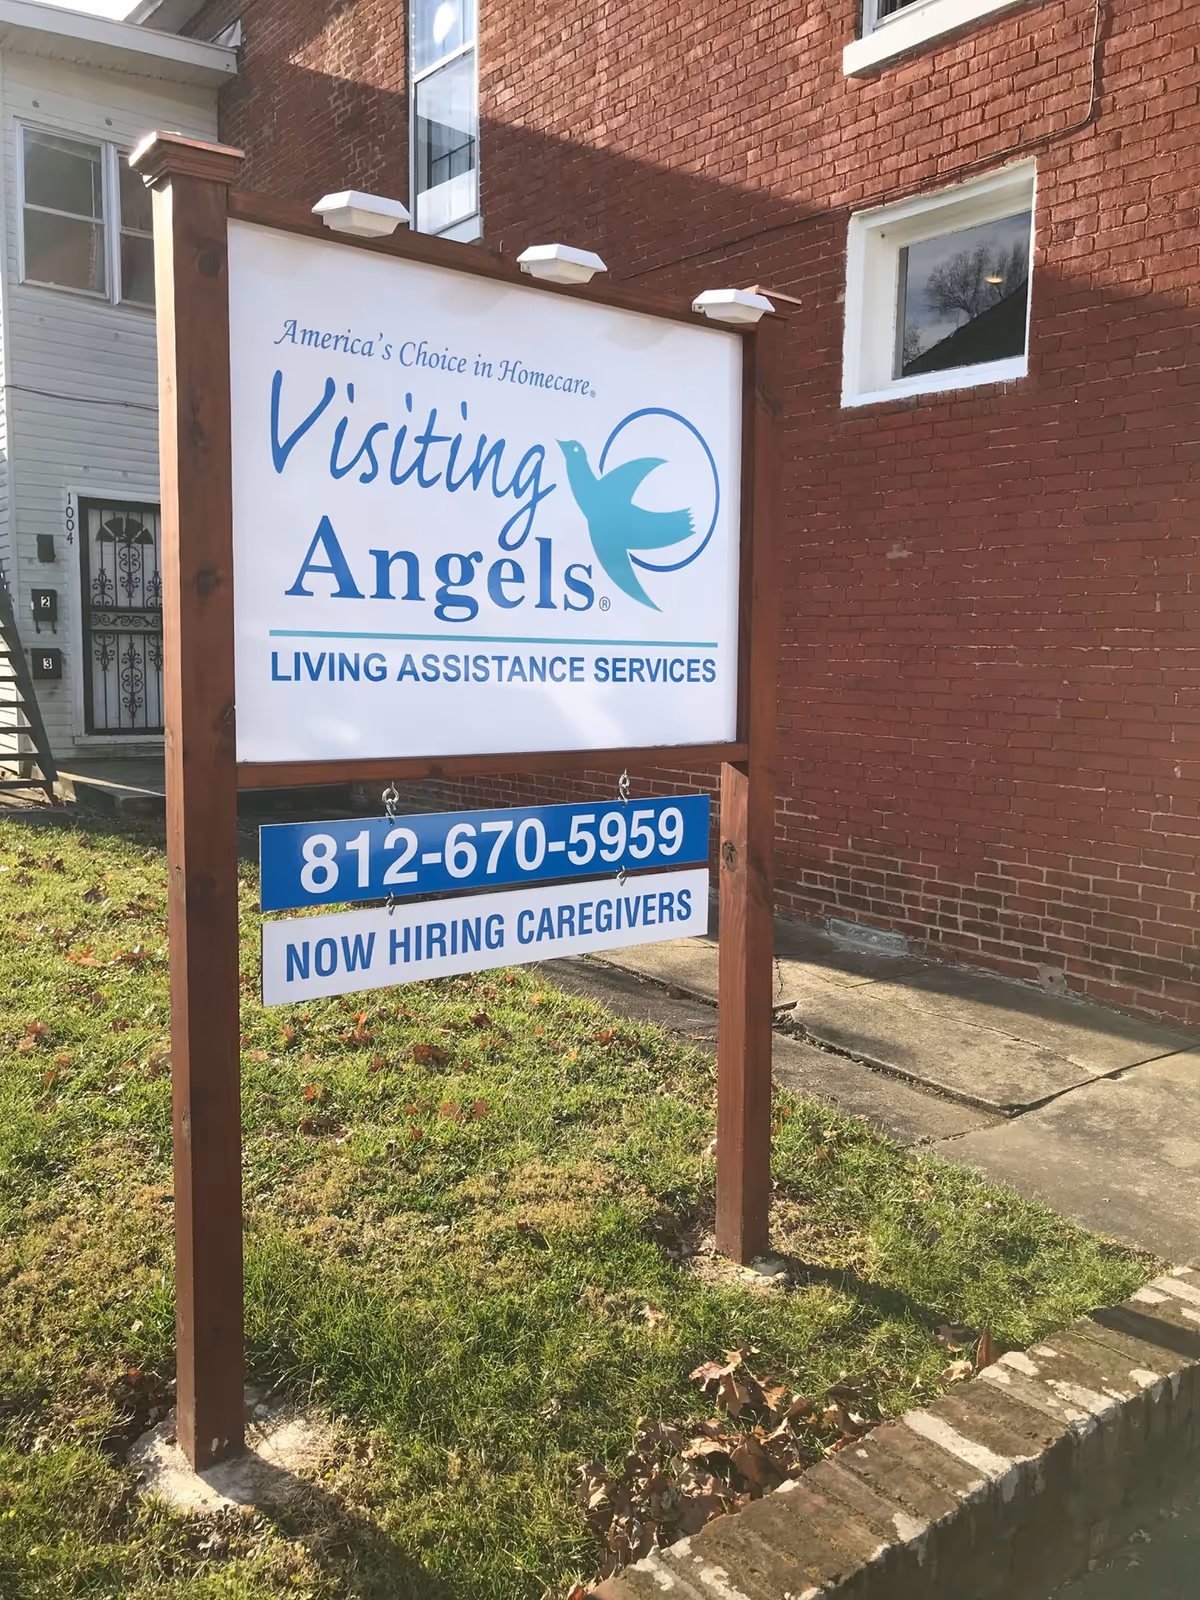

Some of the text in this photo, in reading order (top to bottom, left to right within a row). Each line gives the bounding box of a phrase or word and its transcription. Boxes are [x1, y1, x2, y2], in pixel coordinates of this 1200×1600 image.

[274, 319, 392, 361] America's
[399, 342, 467, 374] Choice
[473, 354, 493, 378] in
[270, 370, 556, 551] Visiting
[65, 492, 75, 545] 1004
[42, 596, 51, 607] 2
[44, 658, 53, 669] 3
[271, 651, 717, 683] LIVING ASSISTANCE SERVICES
[300, 807, 685, 894] 812-670-5959
[286, 889, 692, 982] NOW HIRING CAREGIVERS
